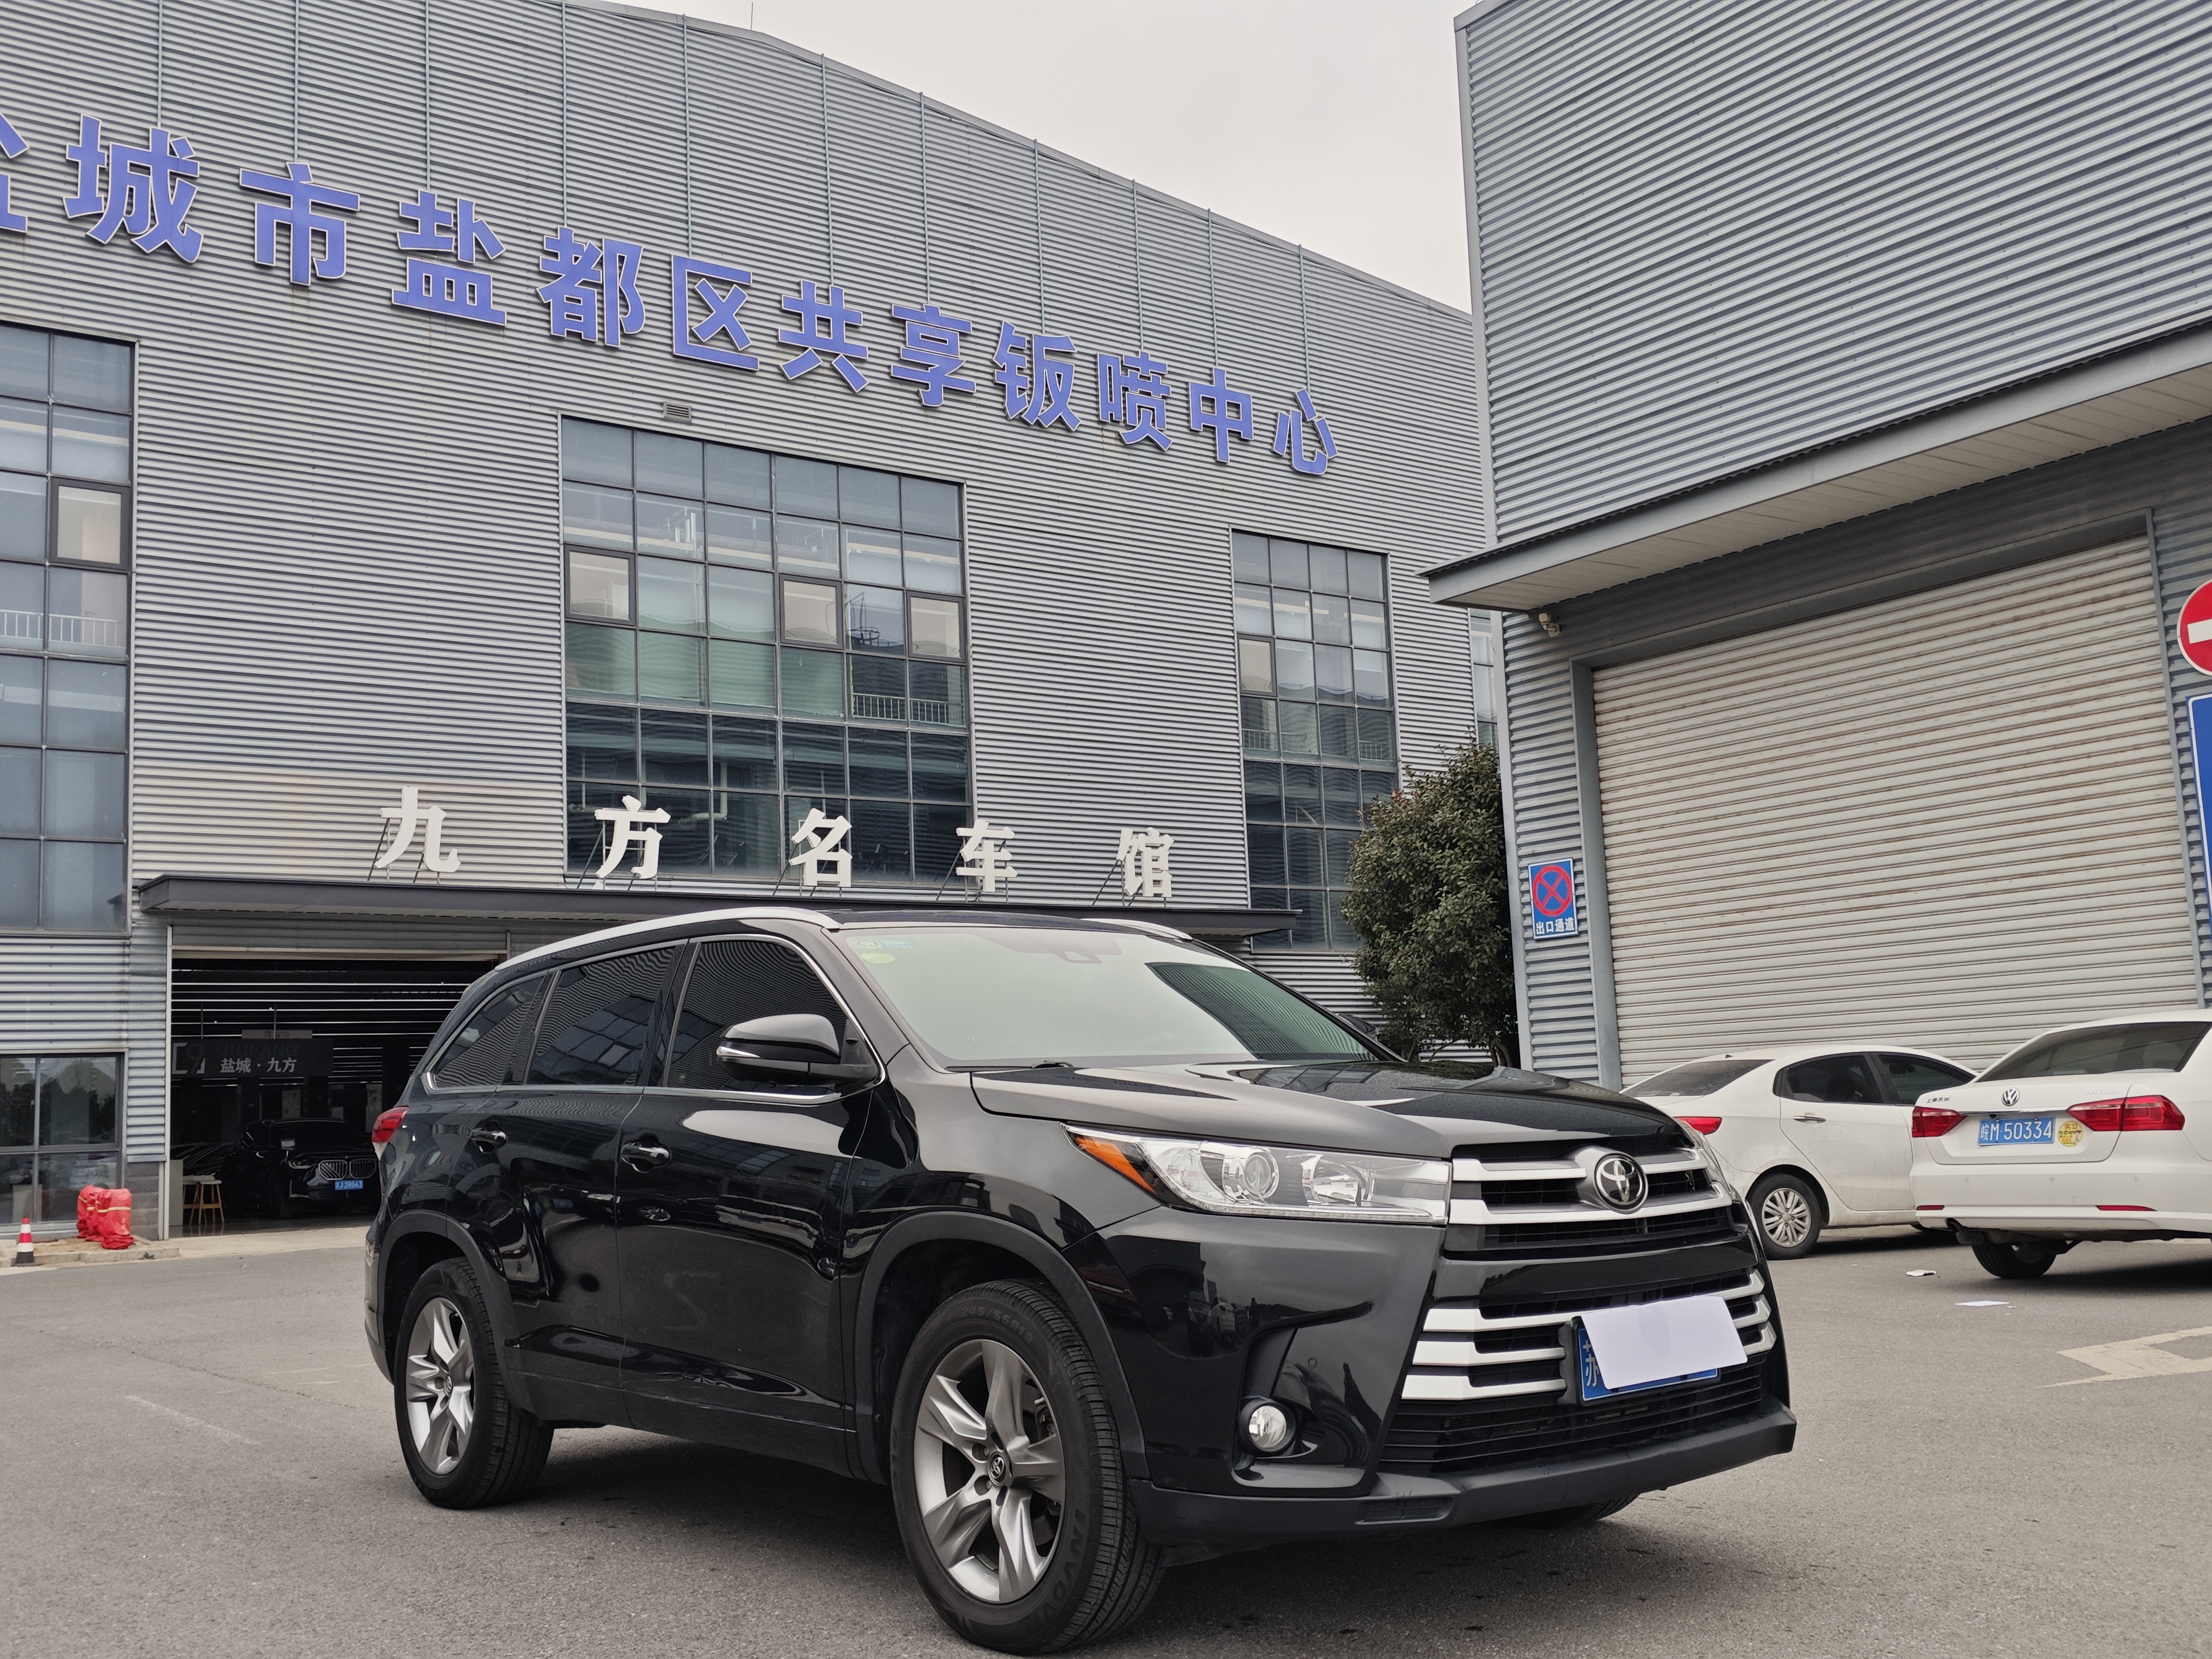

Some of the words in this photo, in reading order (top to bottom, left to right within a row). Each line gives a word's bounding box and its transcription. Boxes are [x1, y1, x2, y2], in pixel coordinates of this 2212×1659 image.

[0, 114, 1338, 475] 城市盐都区共享钣喷中心
[379, 786, 1175, 898] 九方名车馆
[1536, 918, 1574, 934] 出口通道
[960, 1306, 1034, 1344] 245/55R19
